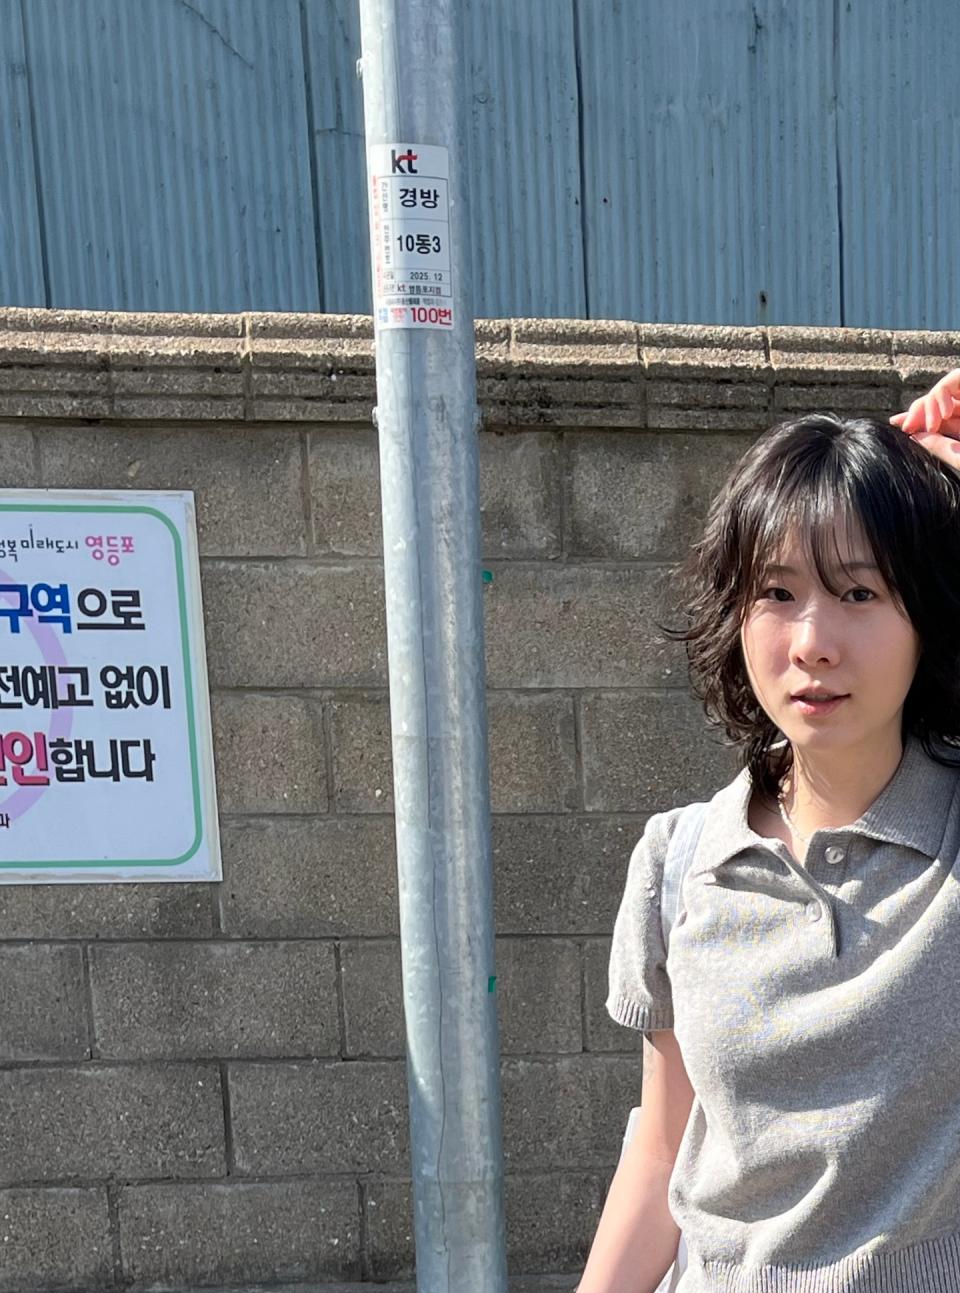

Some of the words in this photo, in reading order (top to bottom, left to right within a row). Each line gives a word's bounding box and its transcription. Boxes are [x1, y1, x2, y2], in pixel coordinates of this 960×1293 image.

[391, 149, 418, 174] kt
[399, 187, 440, 209] 경방
[397, 233, 441, 255] 10동3
[434, 272, 443, 281] 12
[410, 306, 452, 326] 100번
[20, 523, 79, 554] 미래도시
[84, 534, 135, 567] 영등포
[99, 665, 172, 710] 없이
[0, 731, 157, 787] 인합니다
